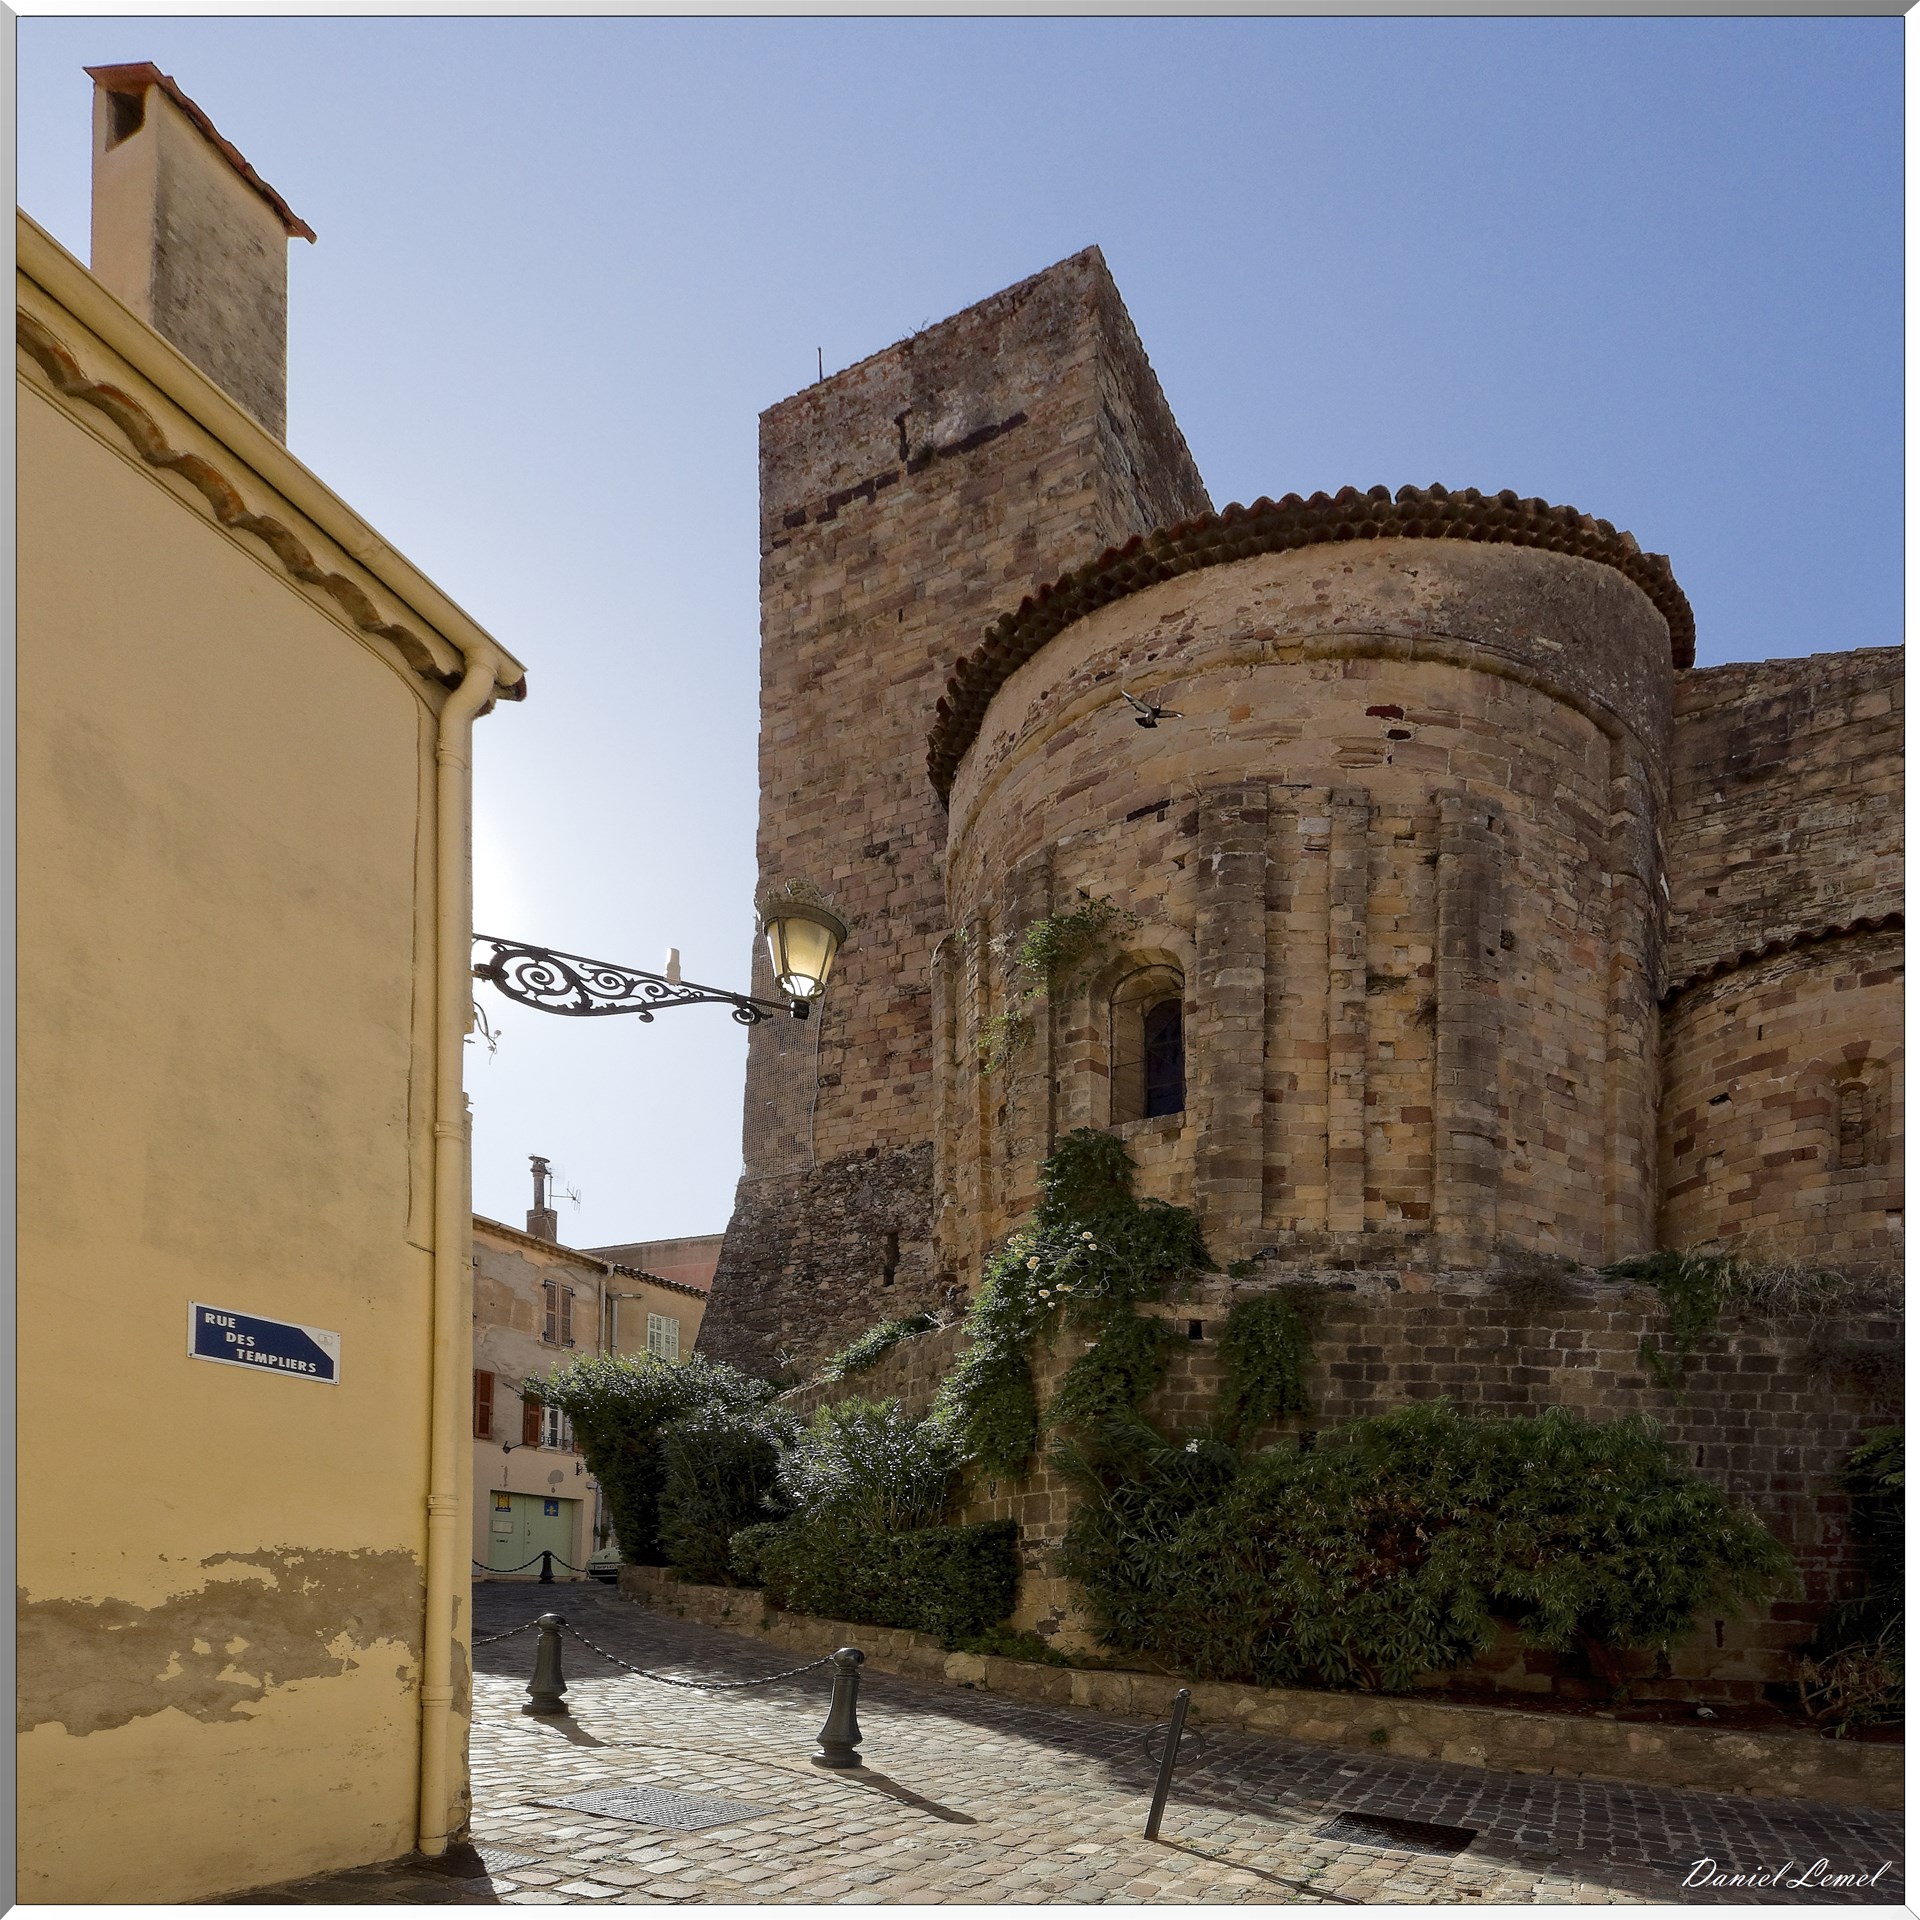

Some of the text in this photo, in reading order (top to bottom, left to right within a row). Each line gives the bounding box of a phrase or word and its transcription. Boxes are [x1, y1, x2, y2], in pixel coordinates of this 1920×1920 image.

[205, 1312, 236, 1329] RUE
[226, 1332, 256, 1347] DES
[236, 1349, 317, 1373] TEMPLIERS
